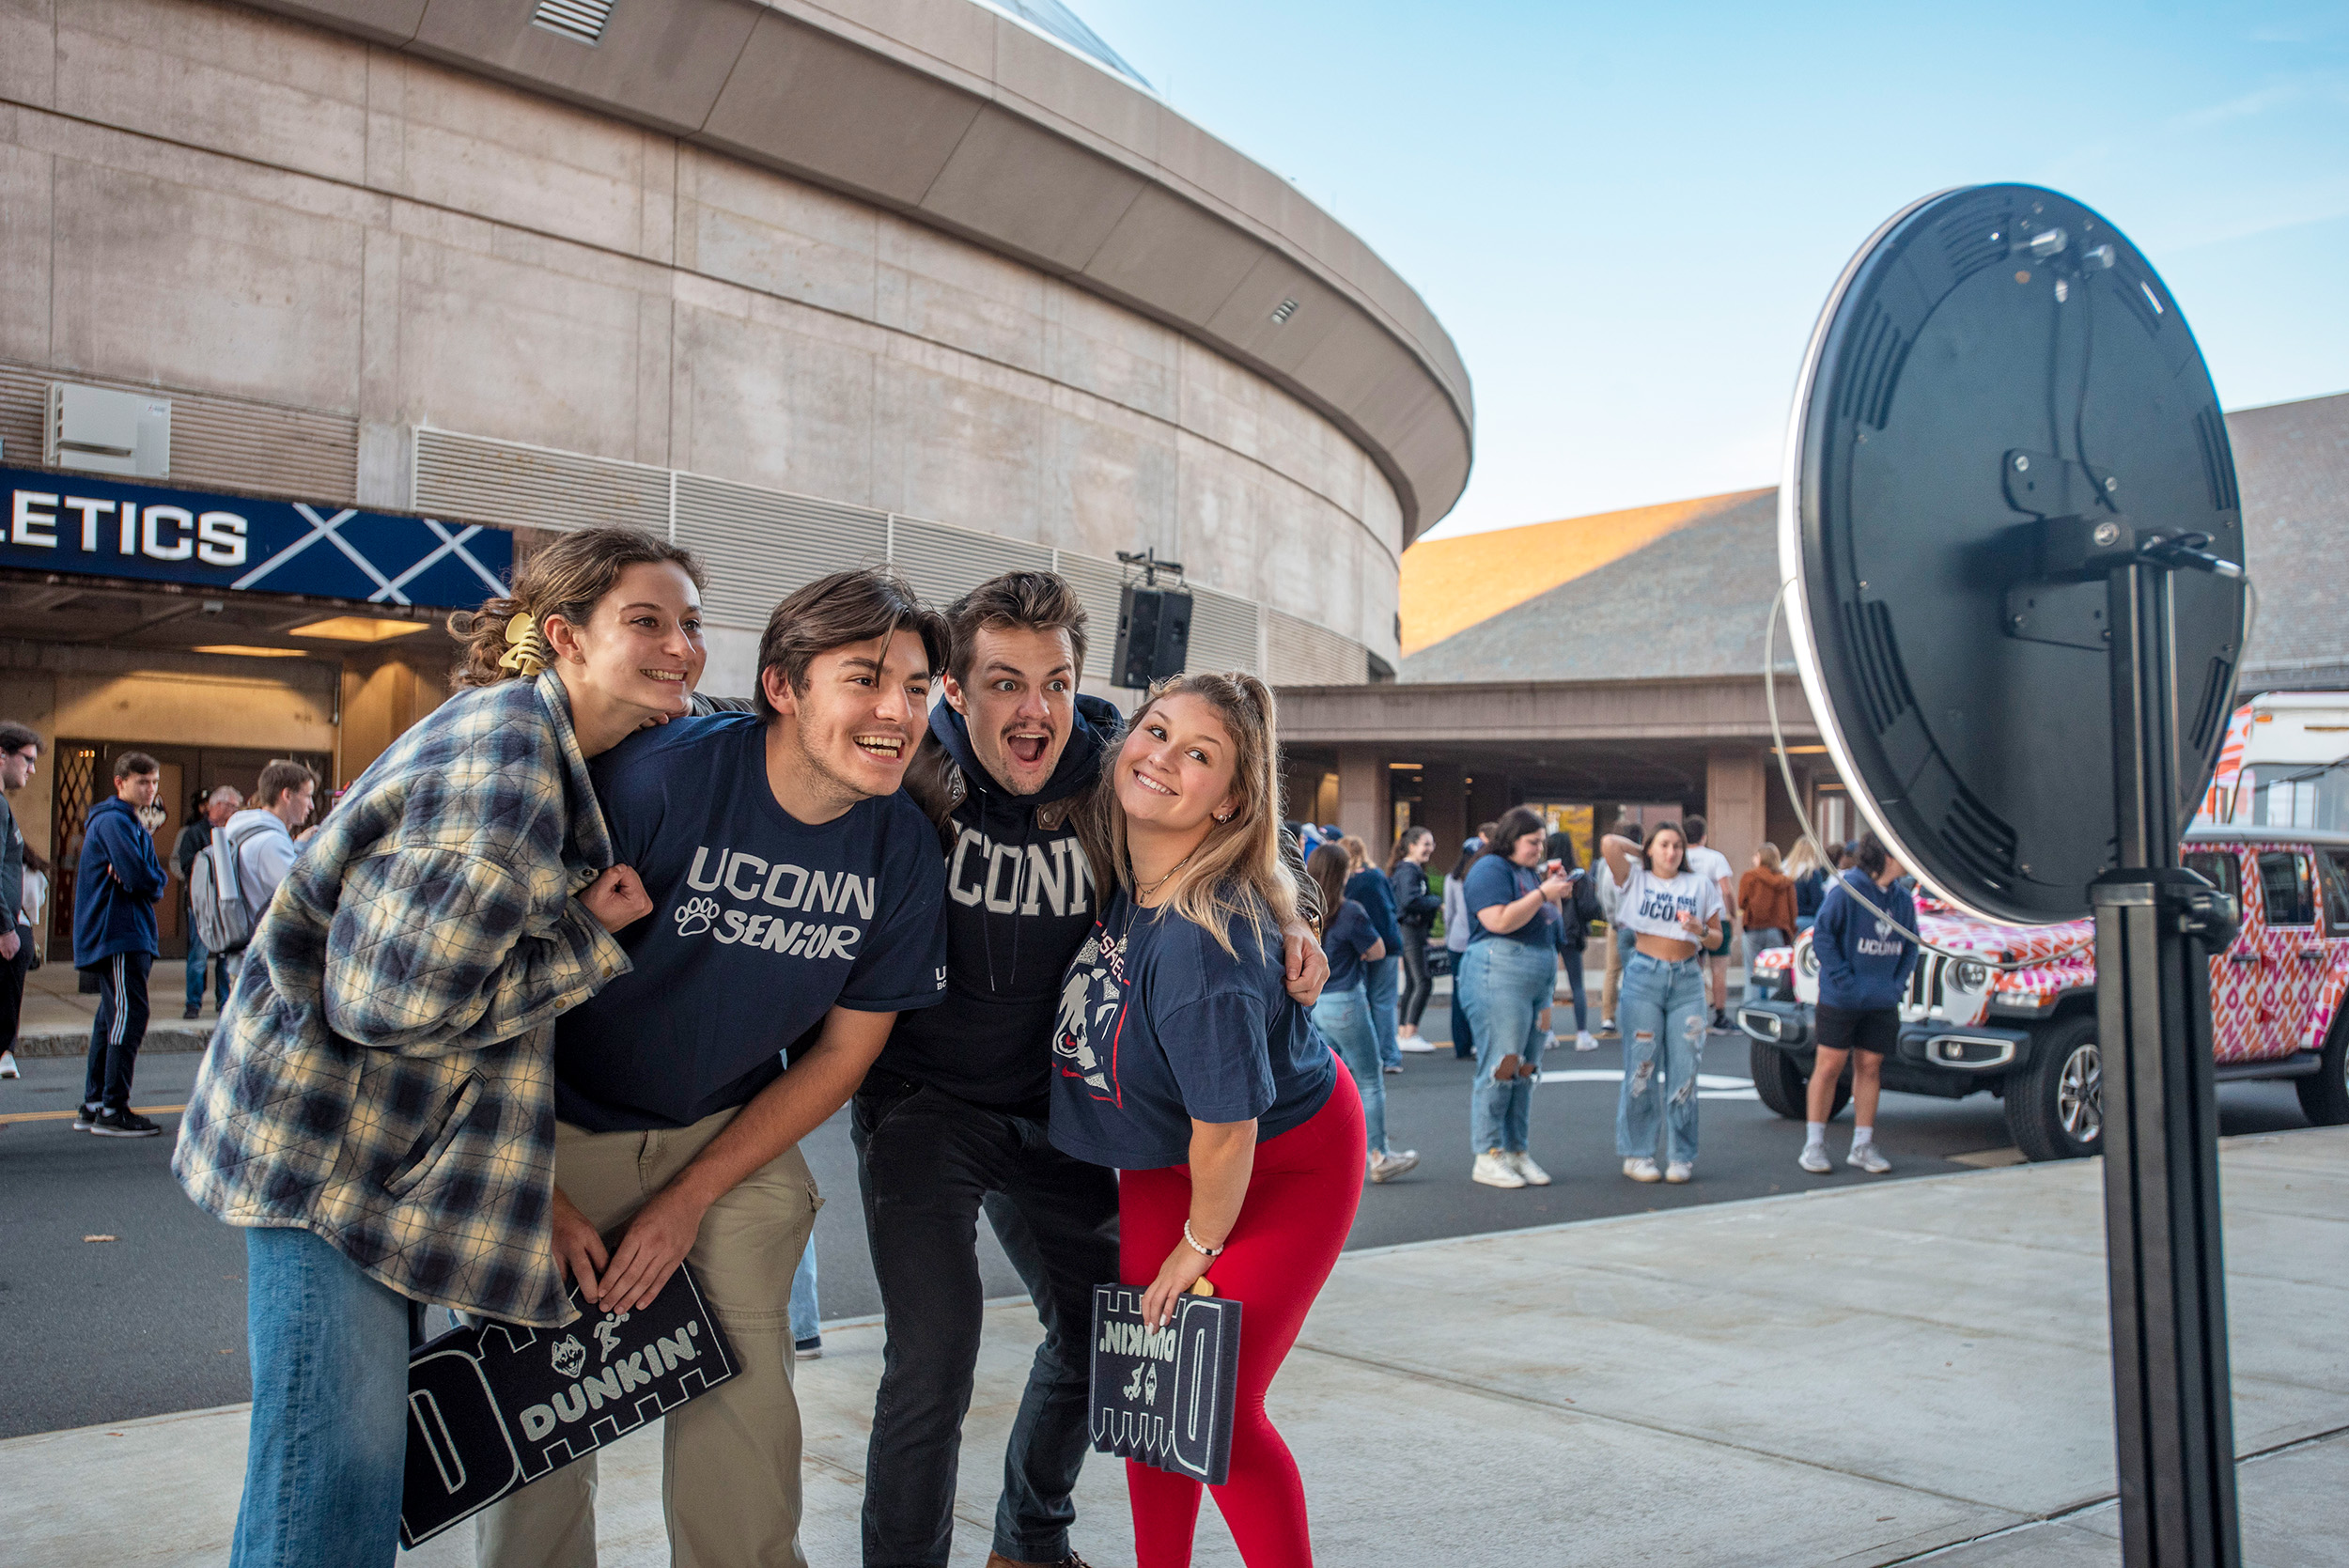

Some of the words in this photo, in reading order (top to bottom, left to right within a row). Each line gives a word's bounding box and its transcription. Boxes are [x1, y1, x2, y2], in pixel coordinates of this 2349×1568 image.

[0, 489, 248, 566] ETICS
[687, 846, 876, 921] UCONN
[945, 817, 1097, 917] CONN
[1640, 899, 1698, 923] UCO
[519, 1321, 699, 1442] DUNKIN'
